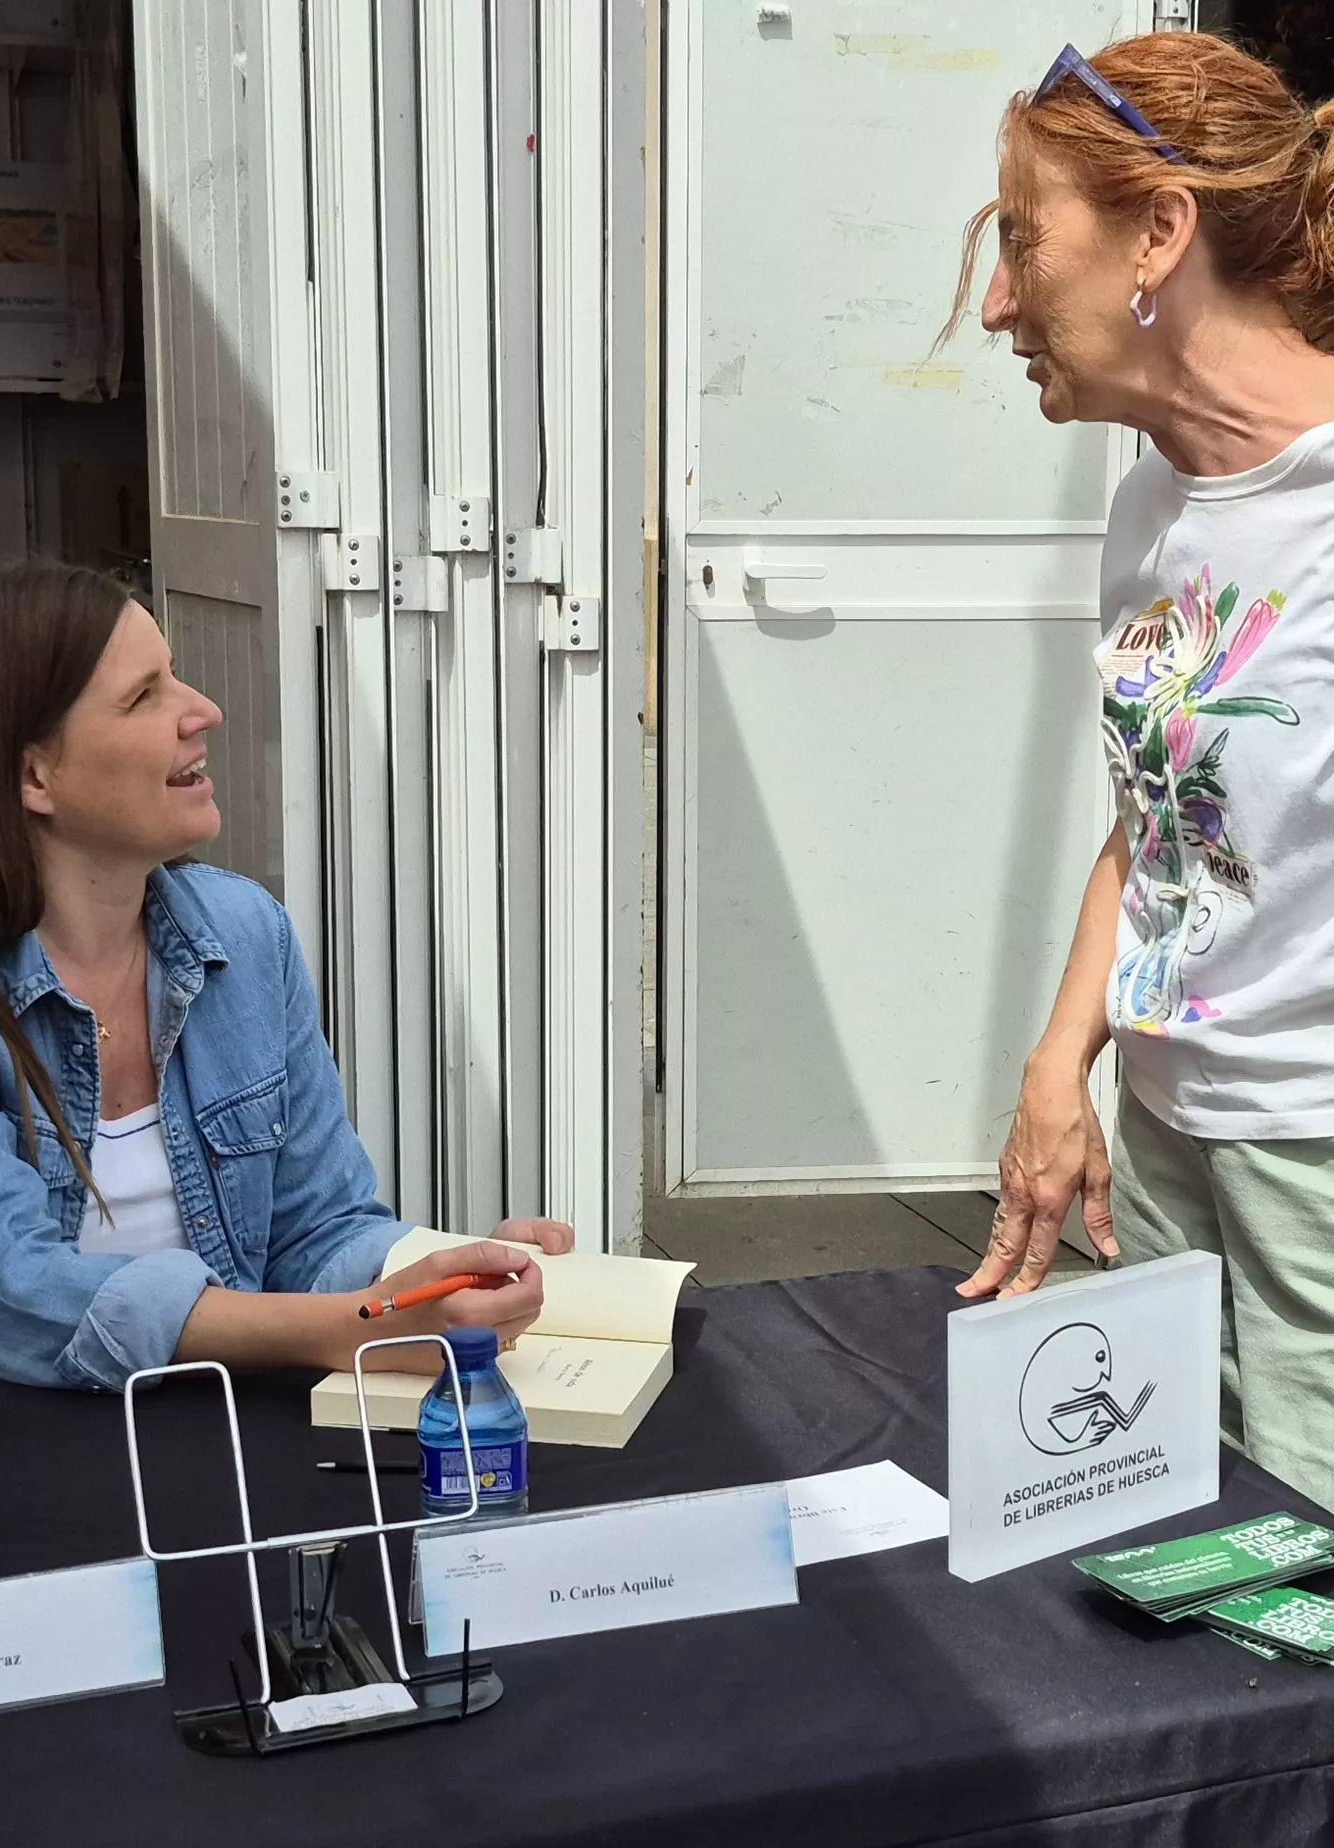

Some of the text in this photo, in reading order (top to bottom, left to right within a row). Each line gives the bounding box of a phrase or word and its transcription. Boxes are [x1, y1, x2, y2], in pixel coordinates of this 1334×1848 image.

[1003, 1445, 1165, 1507] ASOCIACIÓN PROVINCIAL
[1004, 1462, 1170, 1527] DE LIBRERIAS DE HUESCA
[1220, 1517, 1295, 1544] TODOS
[1235, 1533, 1280, 1552] TUS
[1247, 1525, 1330, 1560] LIBROS
[550, 1573, 675, 1603] D. Carlos Aquilué
[1279, 1603, 1326, 1624] TUS
